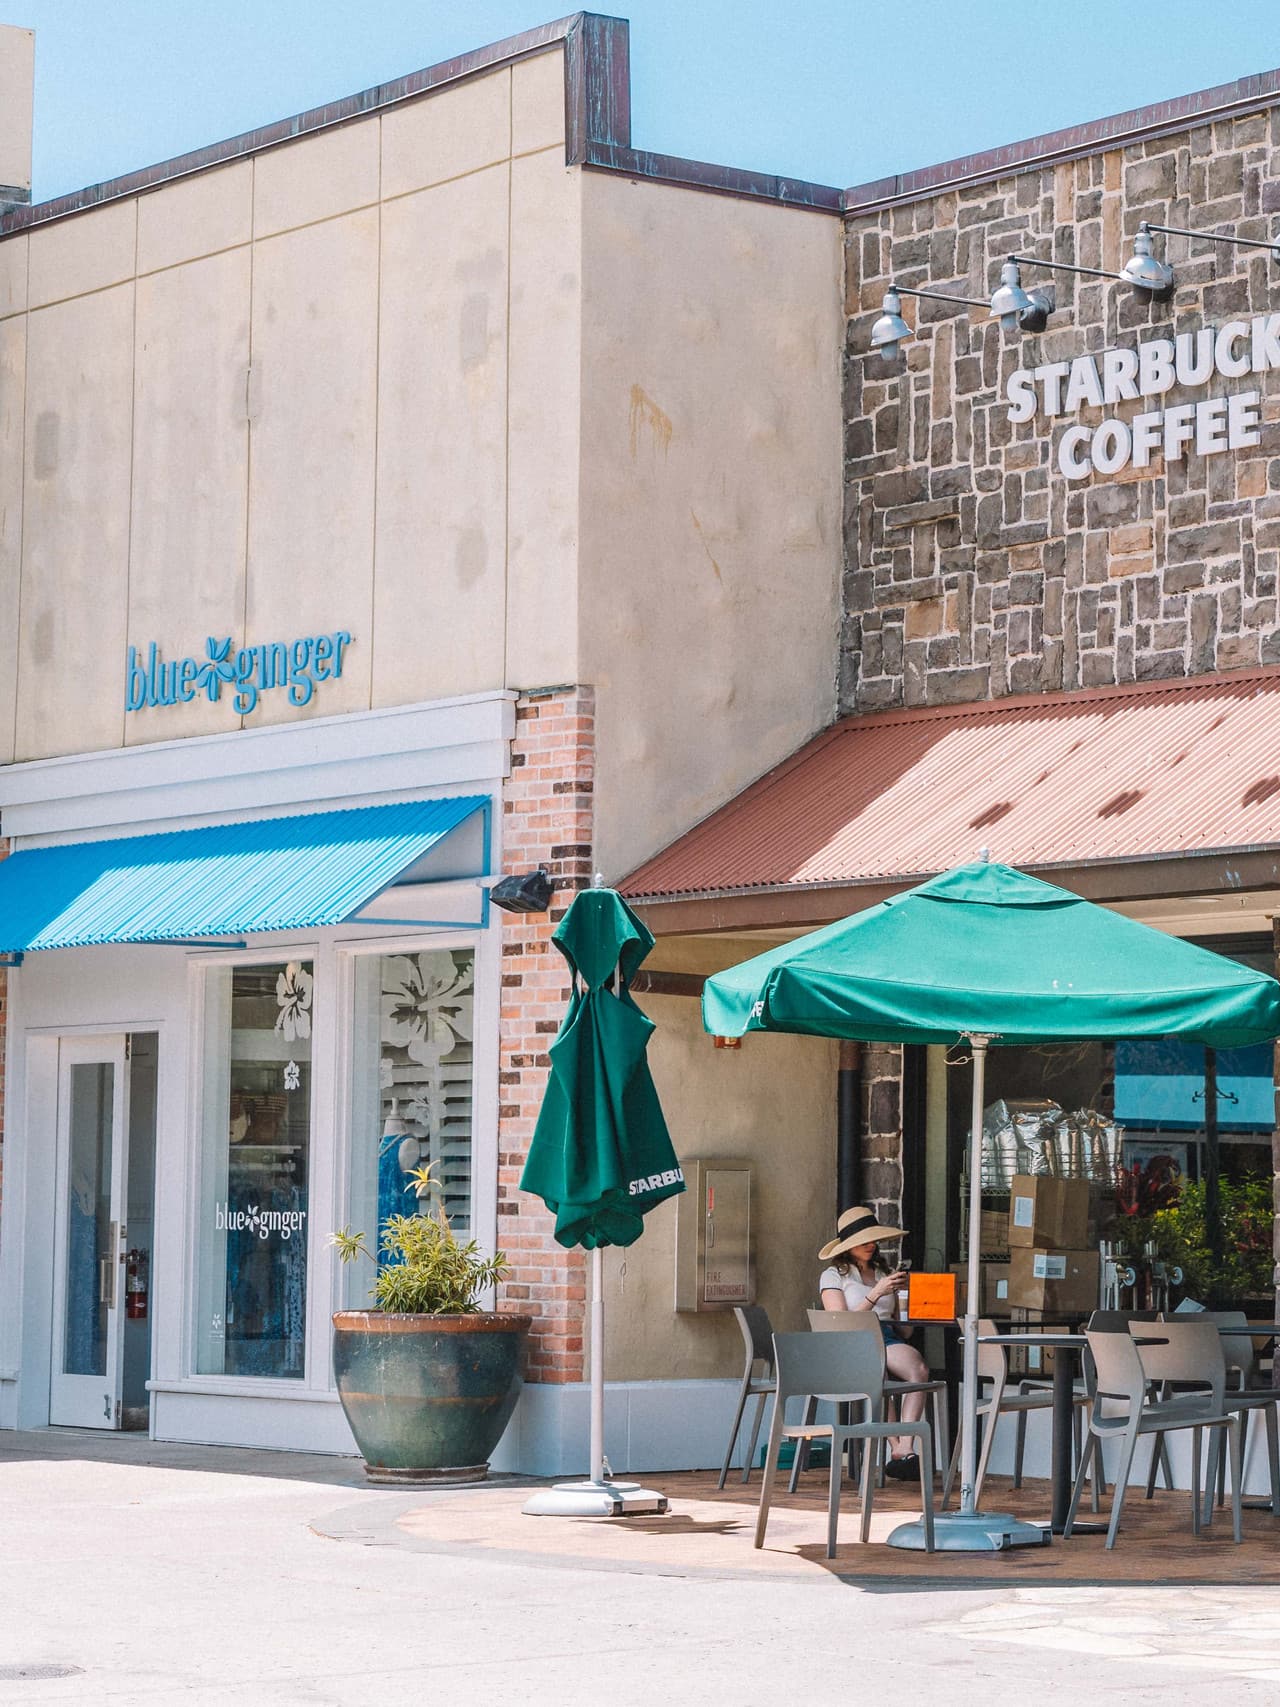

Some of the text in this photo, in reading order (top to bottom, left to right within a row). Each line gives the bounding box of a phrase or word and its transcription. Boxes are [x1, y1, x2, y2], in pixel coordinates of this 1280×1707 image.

[1058, 391, 1262, 481] COFFEE
[125, 631, 350, 715] blue ginger
[215, 1201, 306, 1240] blue ginger
